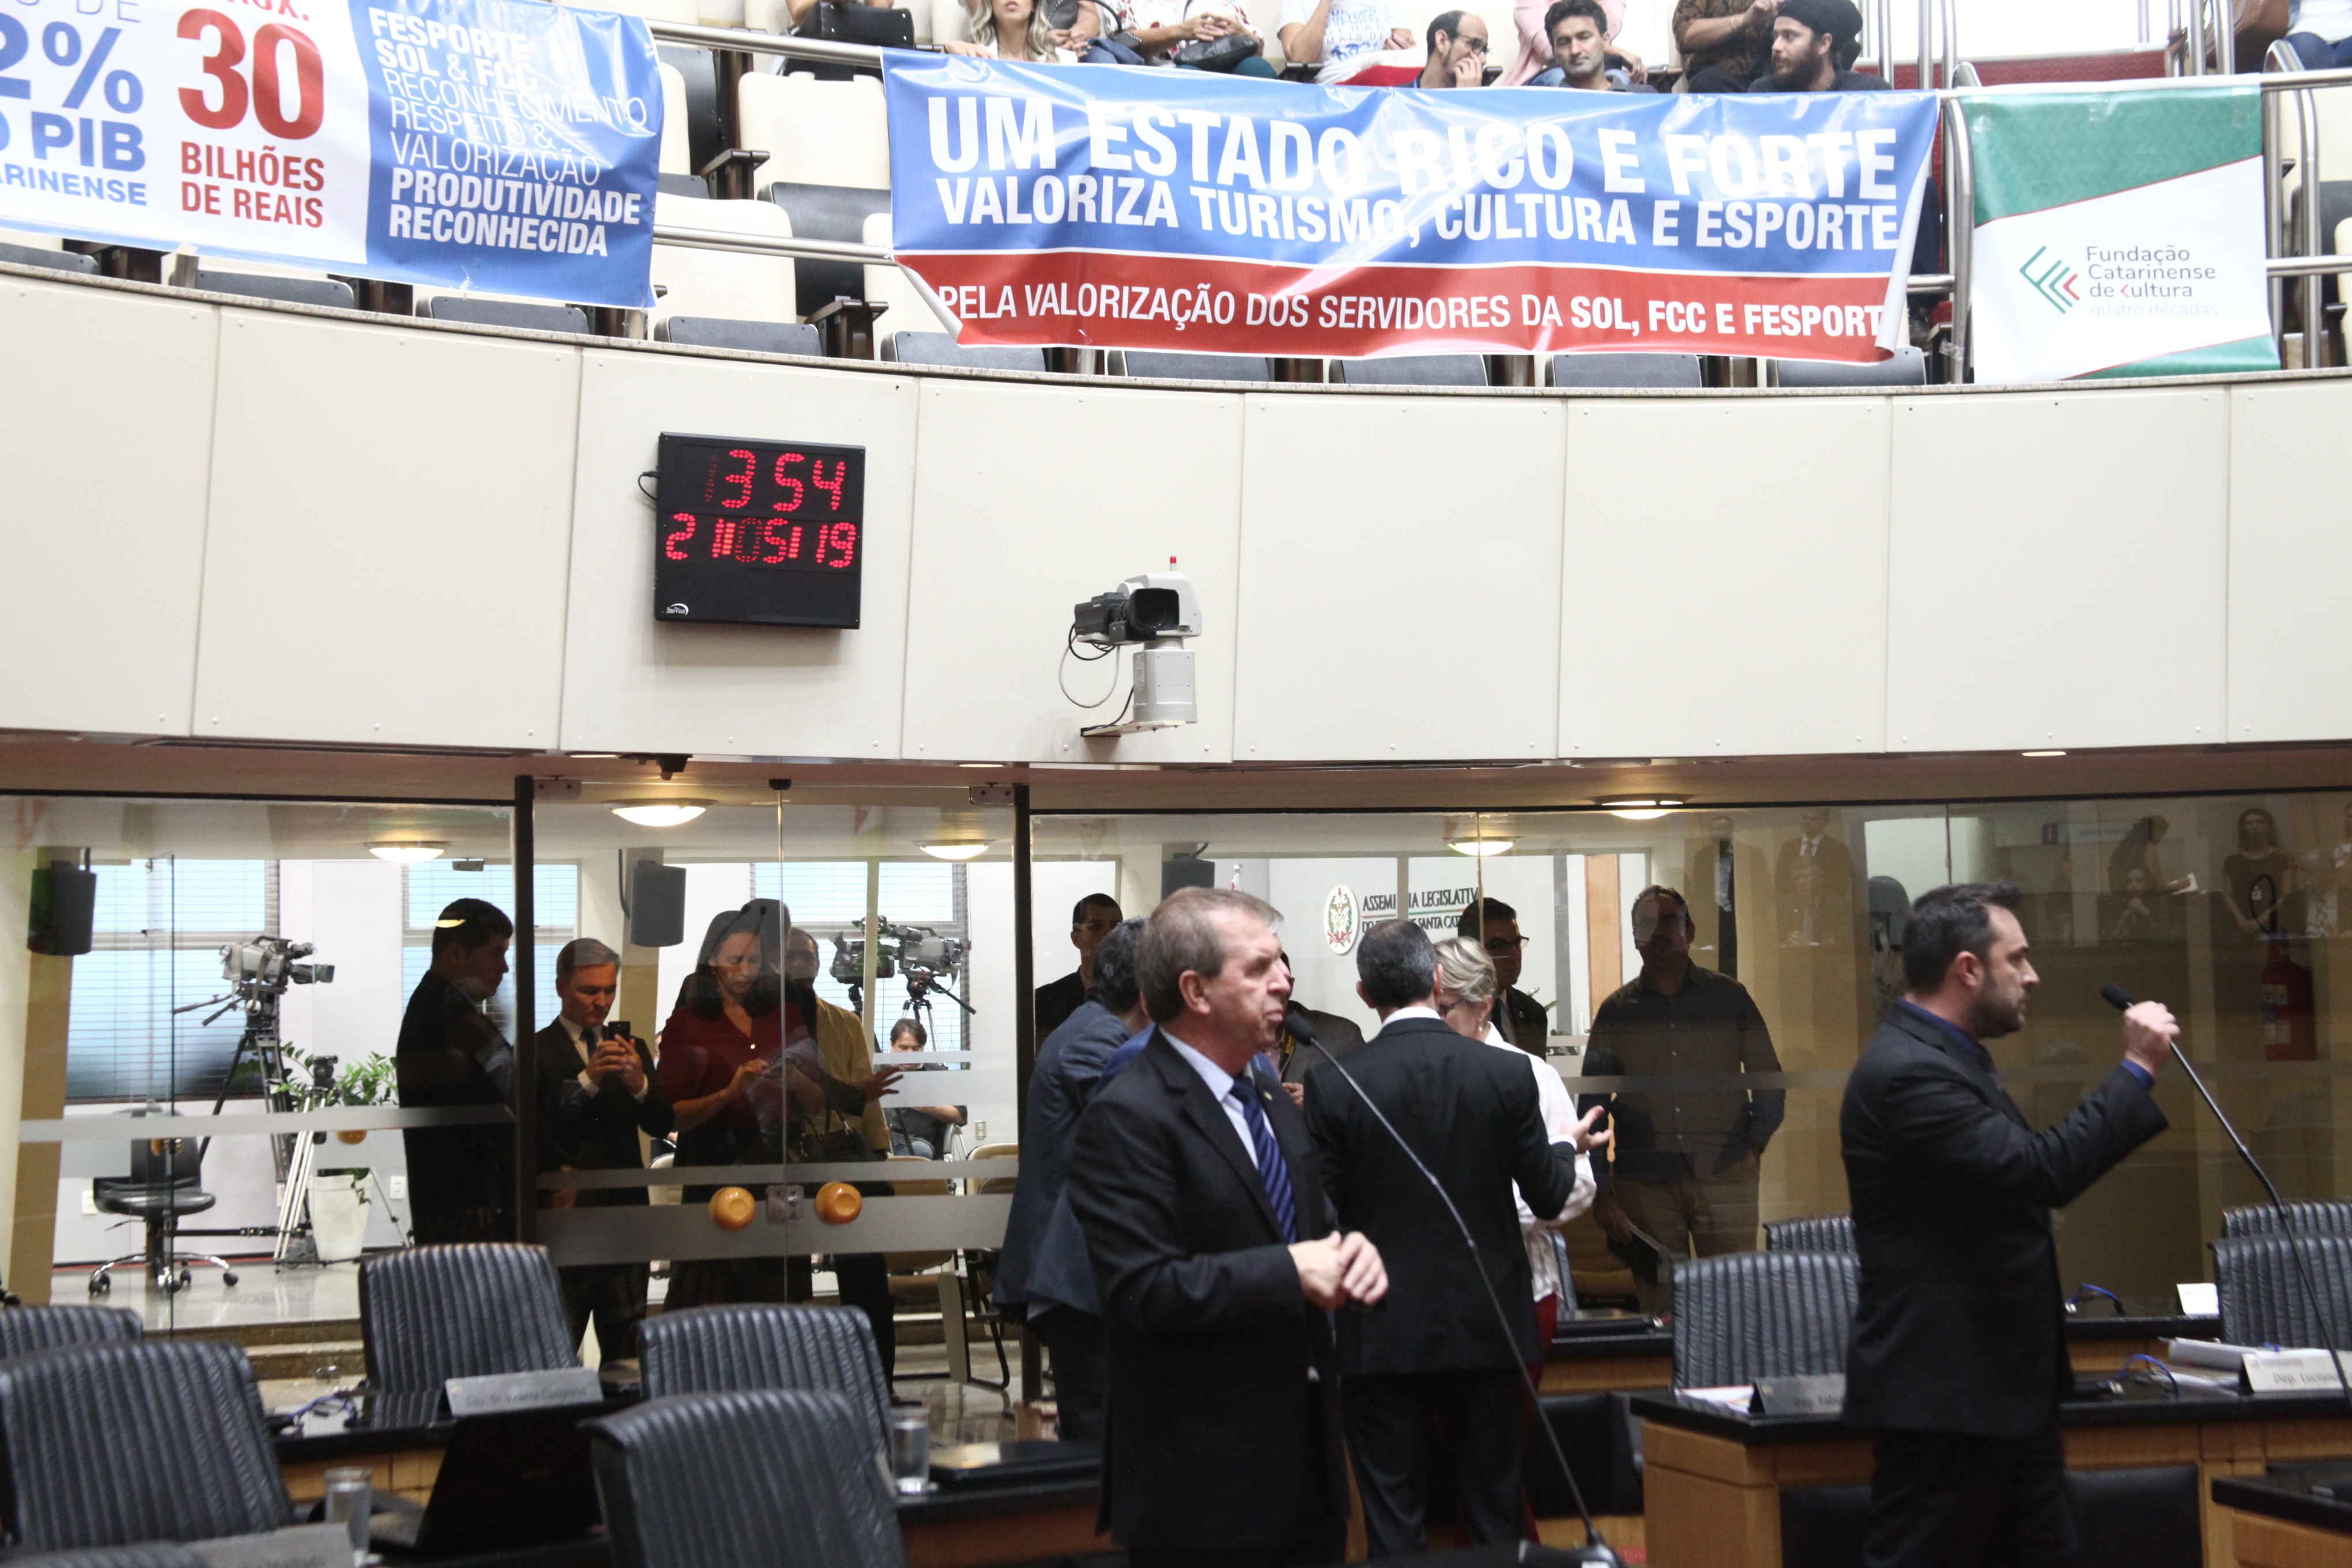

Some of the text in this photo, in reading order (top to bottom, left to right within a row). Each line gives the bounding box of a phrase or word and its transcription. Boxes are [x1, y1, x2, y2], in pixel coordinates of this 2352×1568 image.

[368, 7, 532, 61] FESPORTE
[176, 8, 325, 140] 30
[375, 38, 538, 92] SOL & FCC
[382, 67, 647, 127] RECONHECIMENTO
[391, 96, 557, 150] RESPEITO &
[31, 110, 146, 172] PIB
[180, 141, 325, 193] BILHÕES
[390, 131, 601, 188] VALORIZAÇÃO
[928, 96, 1897, 200] UM ESTADO RICO E FORTE
[0, 163, 148, 206] RINENSE
[181, 180, 324, 228] DE REAIS
[391, 167, 642, 225] PRODUTIVIDADE
[389, 203, 609, 258] RECONHECIDA
[936, 175, 1899, 250] VALORIZA TURISMO, CULTURA E ESPORTE
[2087, 244, 2191, 265] Fundação
[2089, 263, 2216, 280] Catarinense
[938, 282, 1884, 337] PELA VALORIZAÇÃO DOS SERVIDORES DA SOL, FCC E FESPORT
[2090, 282, 2114, 297] de
[2090, 301, 2219, 318] quatro décadas
[1362, 887, 1479, 911] ASSEMIA LEGISLATIV
